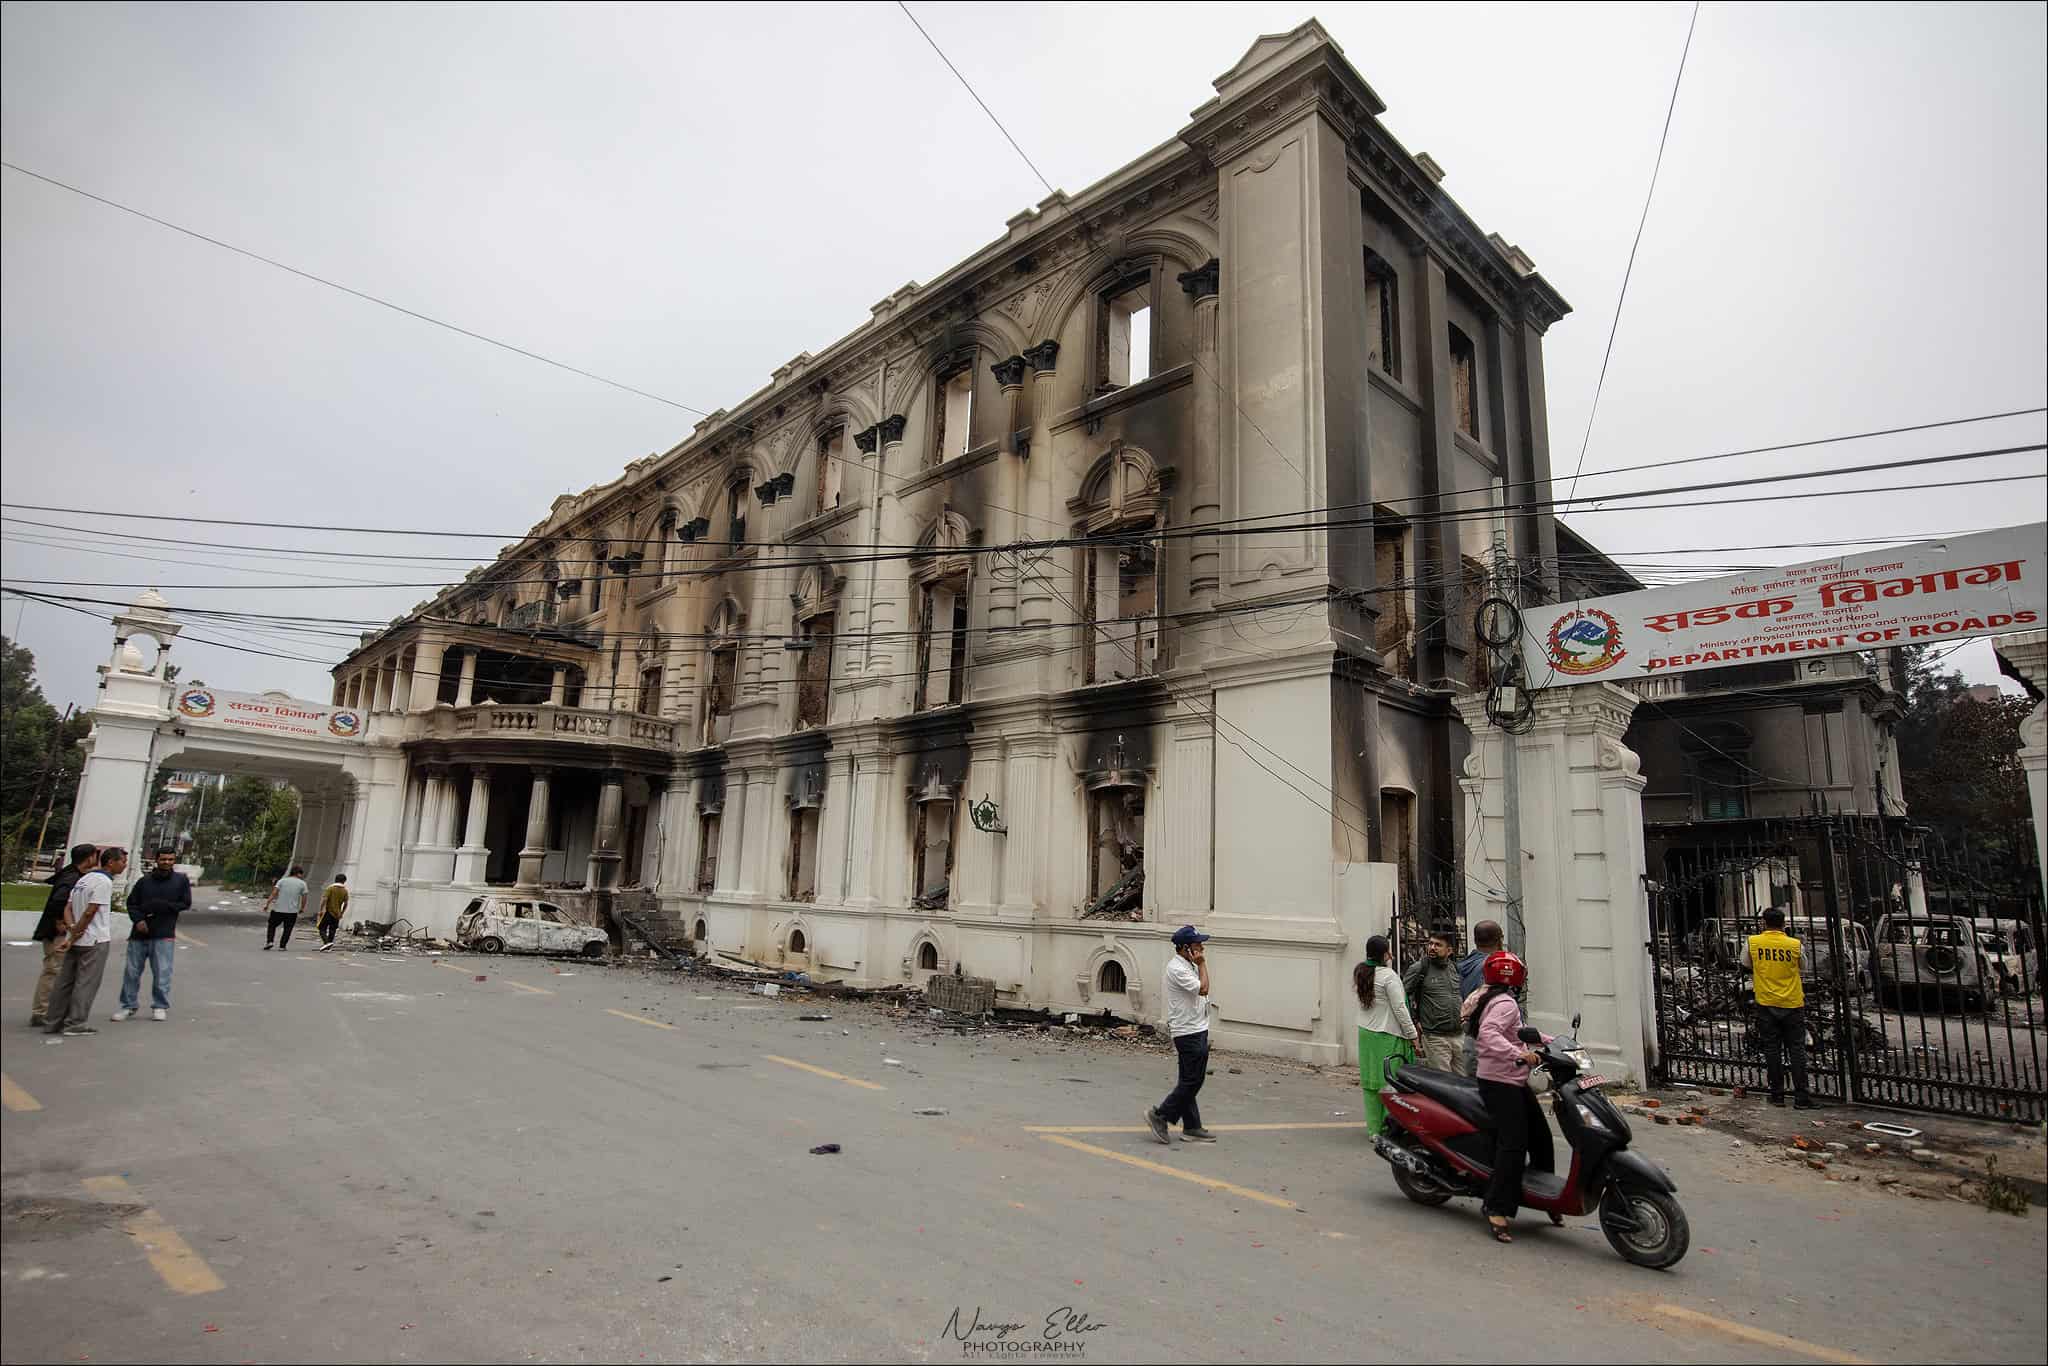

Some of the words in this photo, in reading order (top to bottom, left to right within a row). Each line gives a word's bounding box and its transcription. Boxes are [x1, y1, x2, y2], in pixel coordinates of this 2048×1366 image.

[1811, 562, 1839, 573] सरकार
[1643, 594, 1798, 633] सडक
[1818, 559, 2026, 609] विभाग
[1699, 638, 1737, 650] Ministry
[1740, 636, 1751, 645] of
[1753, 631, 1795, 643] Physical
[1797, 622, 1872, 638] Infrastructure
[1875, 616, 1898, 627] and
[1901, 609, 1960, 624] Transport
[1763, 618, 1829, 633] Government
[1832, 616, 1843, 624] of
[1846, 611, 1879, 623] Nepal
[1648, 634, 1849, 669] DEPARTMENT
[1856, 628, 1901, 644] OF
[1909, 610, 2038, 638] ROADS
[229, 702, 270, 713] सडक
[224, 718, 277, 729] DEPARTMENT
[291, 727, 318, 735] ROADS
[1758, 947, 1792, 963] PRESS
